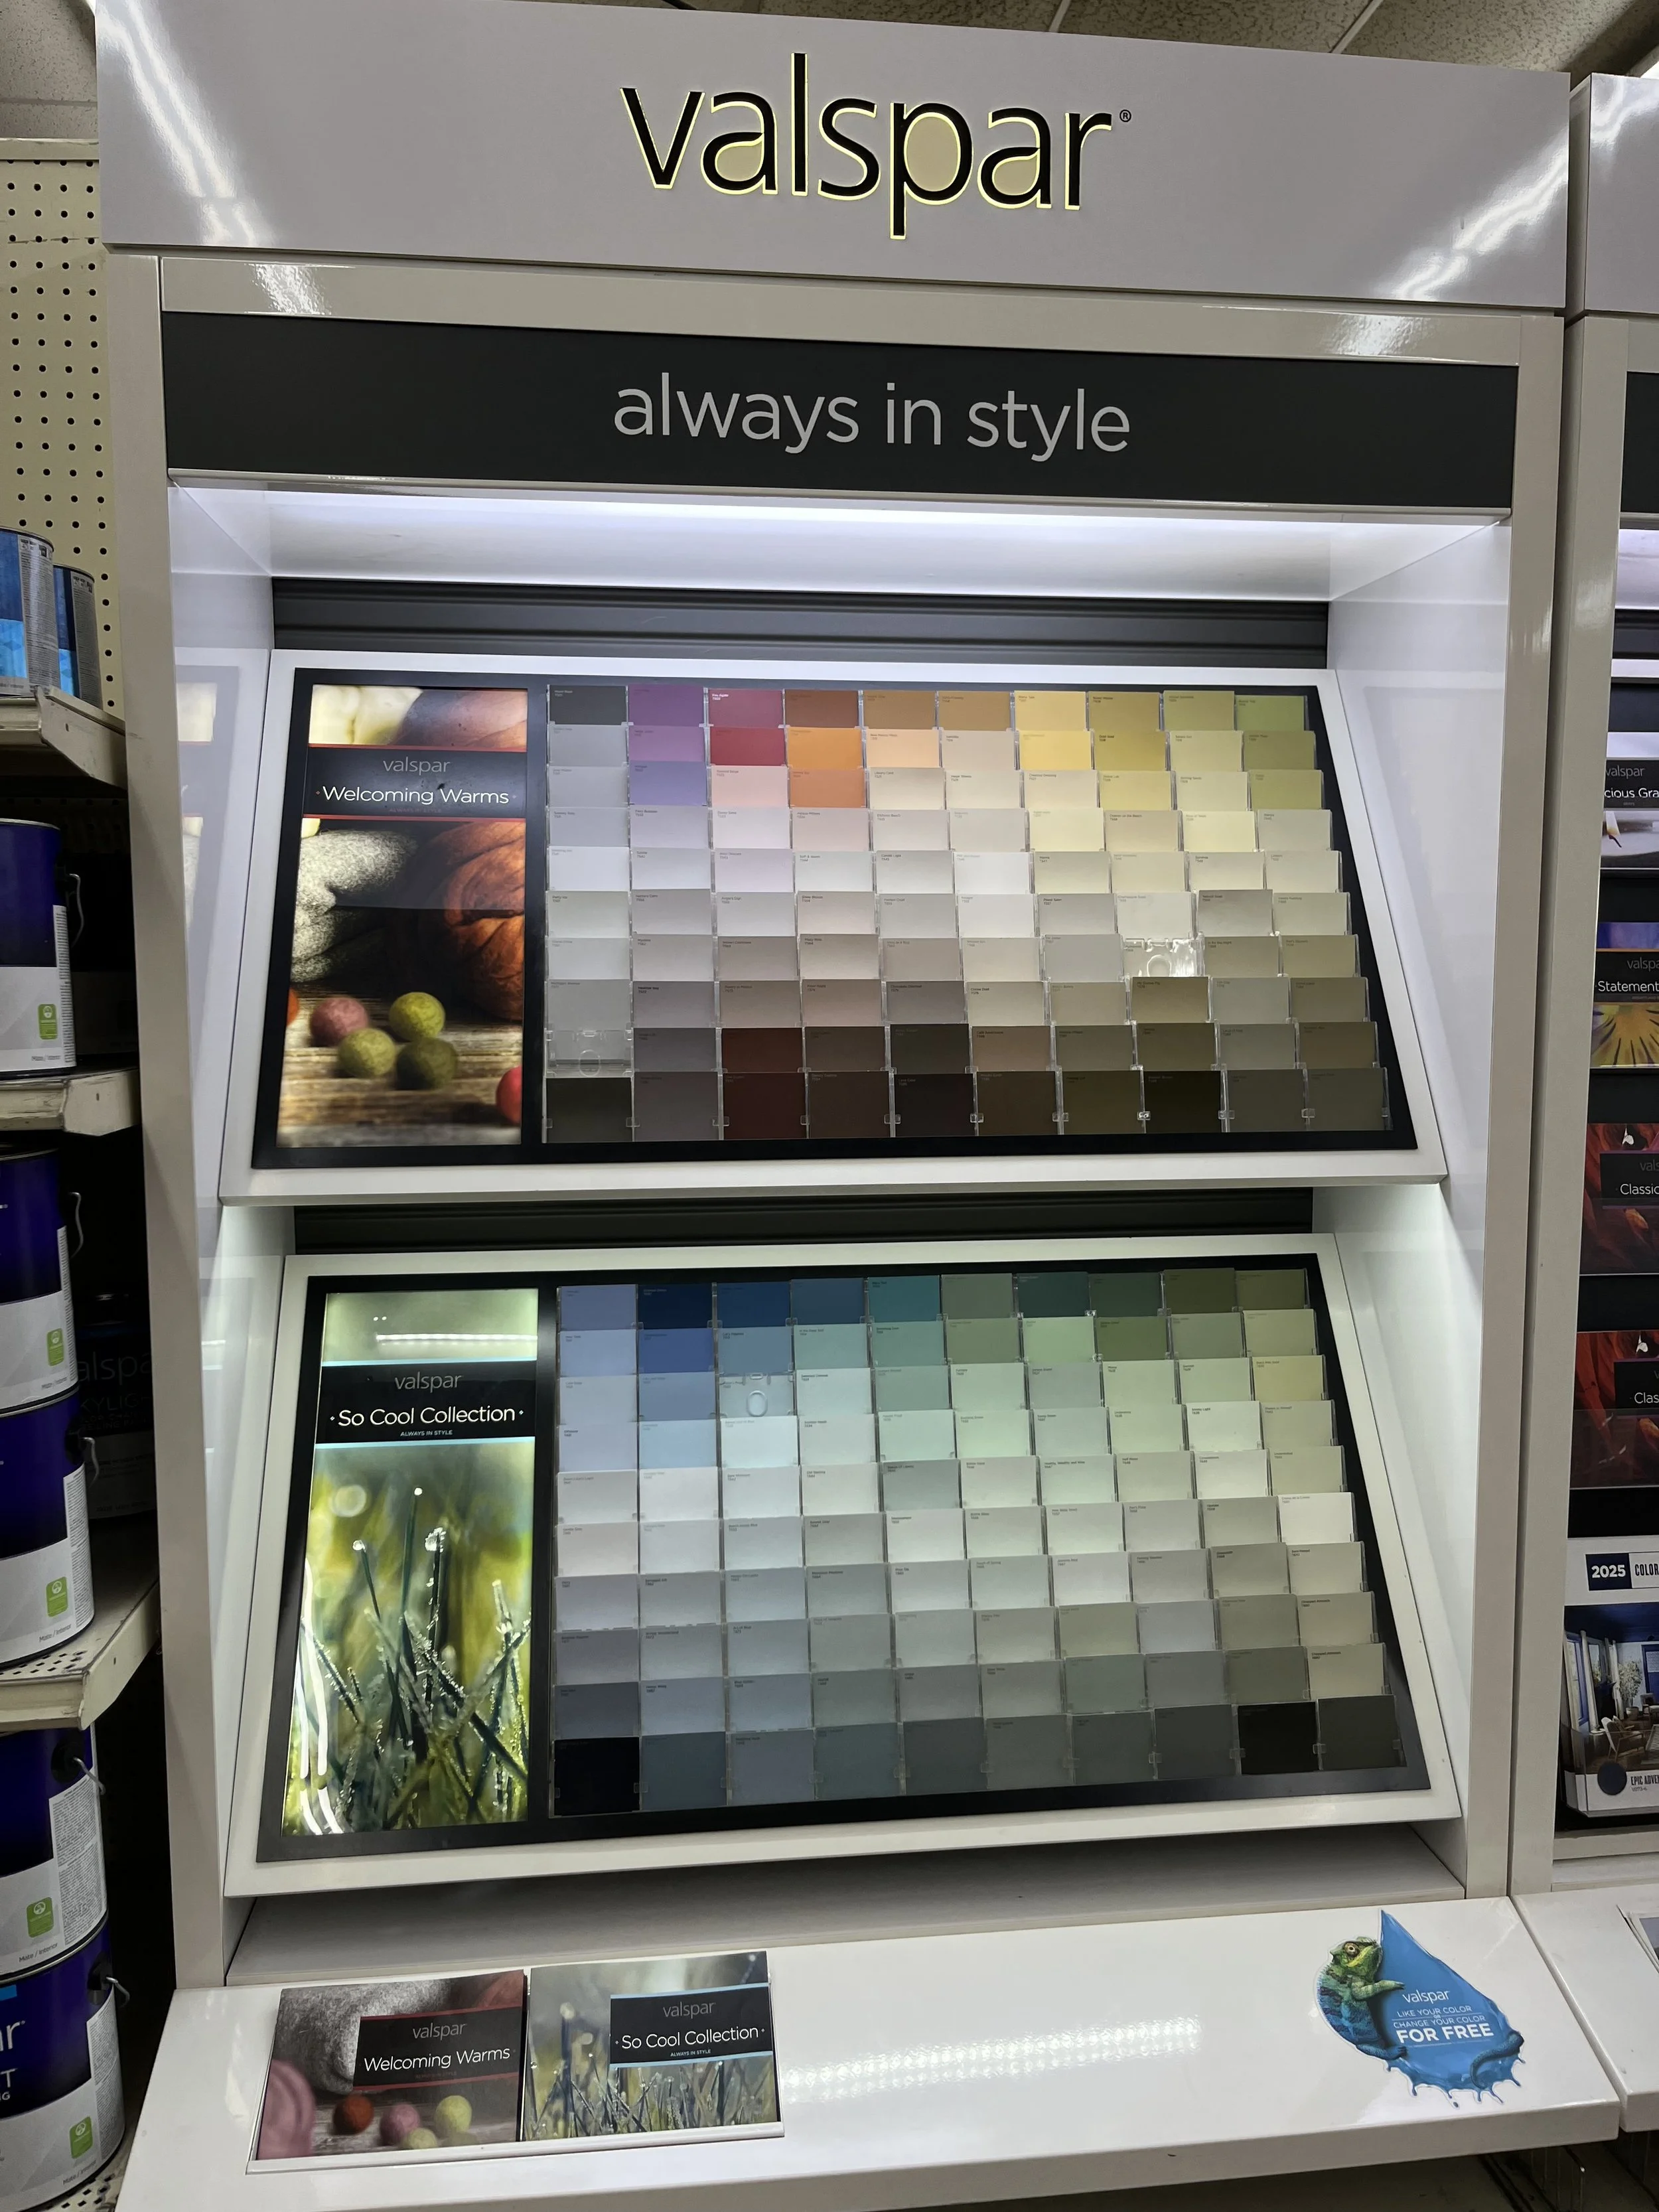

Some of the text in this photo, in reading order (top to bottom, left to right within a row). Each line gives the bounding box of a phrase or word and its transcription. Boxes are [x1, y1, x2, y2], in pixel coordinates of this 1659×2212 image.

[614, 372, 1131, 463] always in style
[384, 756, 451, 776] valspar
[322, 786, 510, 806] Welcoming Warms
[395, 1372, 463, 1393] valspar
[338, 1404, 516, 1428] So Cool Collection
[1591, 1564, 1626, 1579] 2025
[1630, 1776, 1644, 1786] EPIC
[1402, 1989, 1450, 2004] valspar
[662, 2001, 716, 2019] valspar
[1396, 2005, 1473, 2018] LIKE YOUR COLOR
[412, 2022, 467, 2041] valspar
[1393, 2020, 1429, 2029] CHANGE
[1457, 2015, 1486, 2024] COLOR
[621, 2025, 759, 2050] So Cool Collection
[1396, 2022, 1494, 2044] FOR FREE
[364, 2047, 511, 2073] Welcoming Warms
